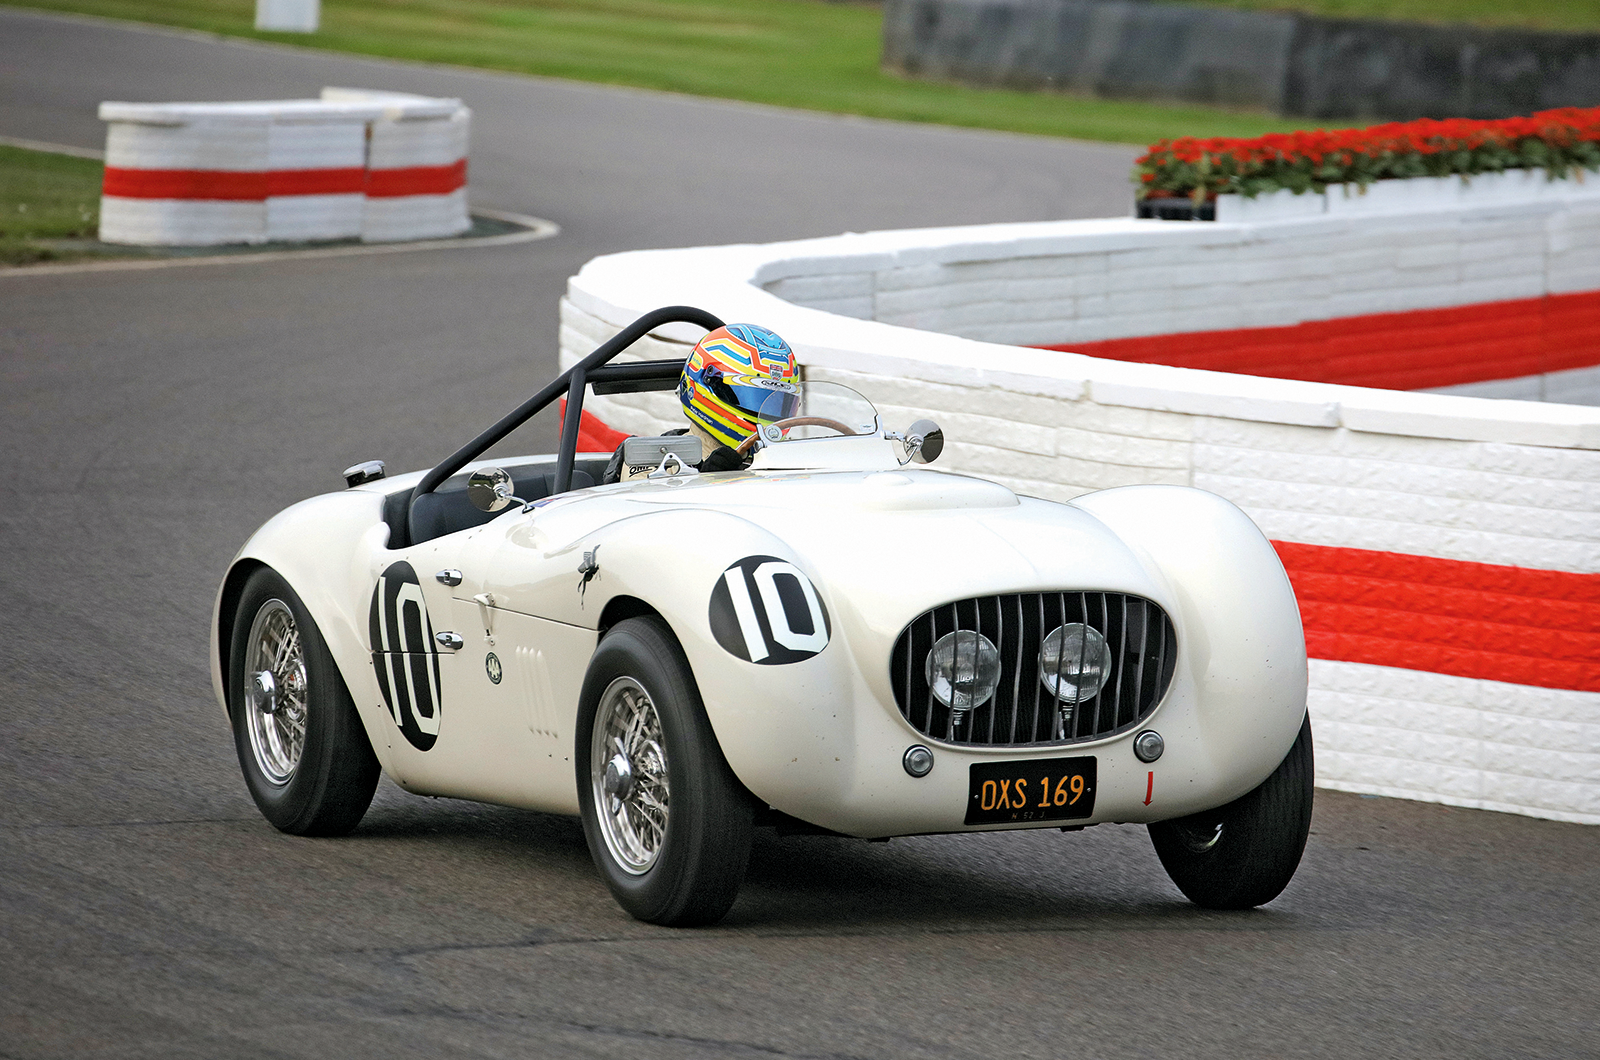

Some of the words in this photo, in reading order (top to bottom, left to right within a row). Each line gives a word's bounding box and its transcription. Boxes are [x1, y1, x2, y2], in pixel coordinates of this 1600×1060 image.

[378, 576, 442, 736] 10
[724, 561, 829, 663] 10
[981, 778, 1028, 811] OXS
[1038, 775, 1085, 808] 169
